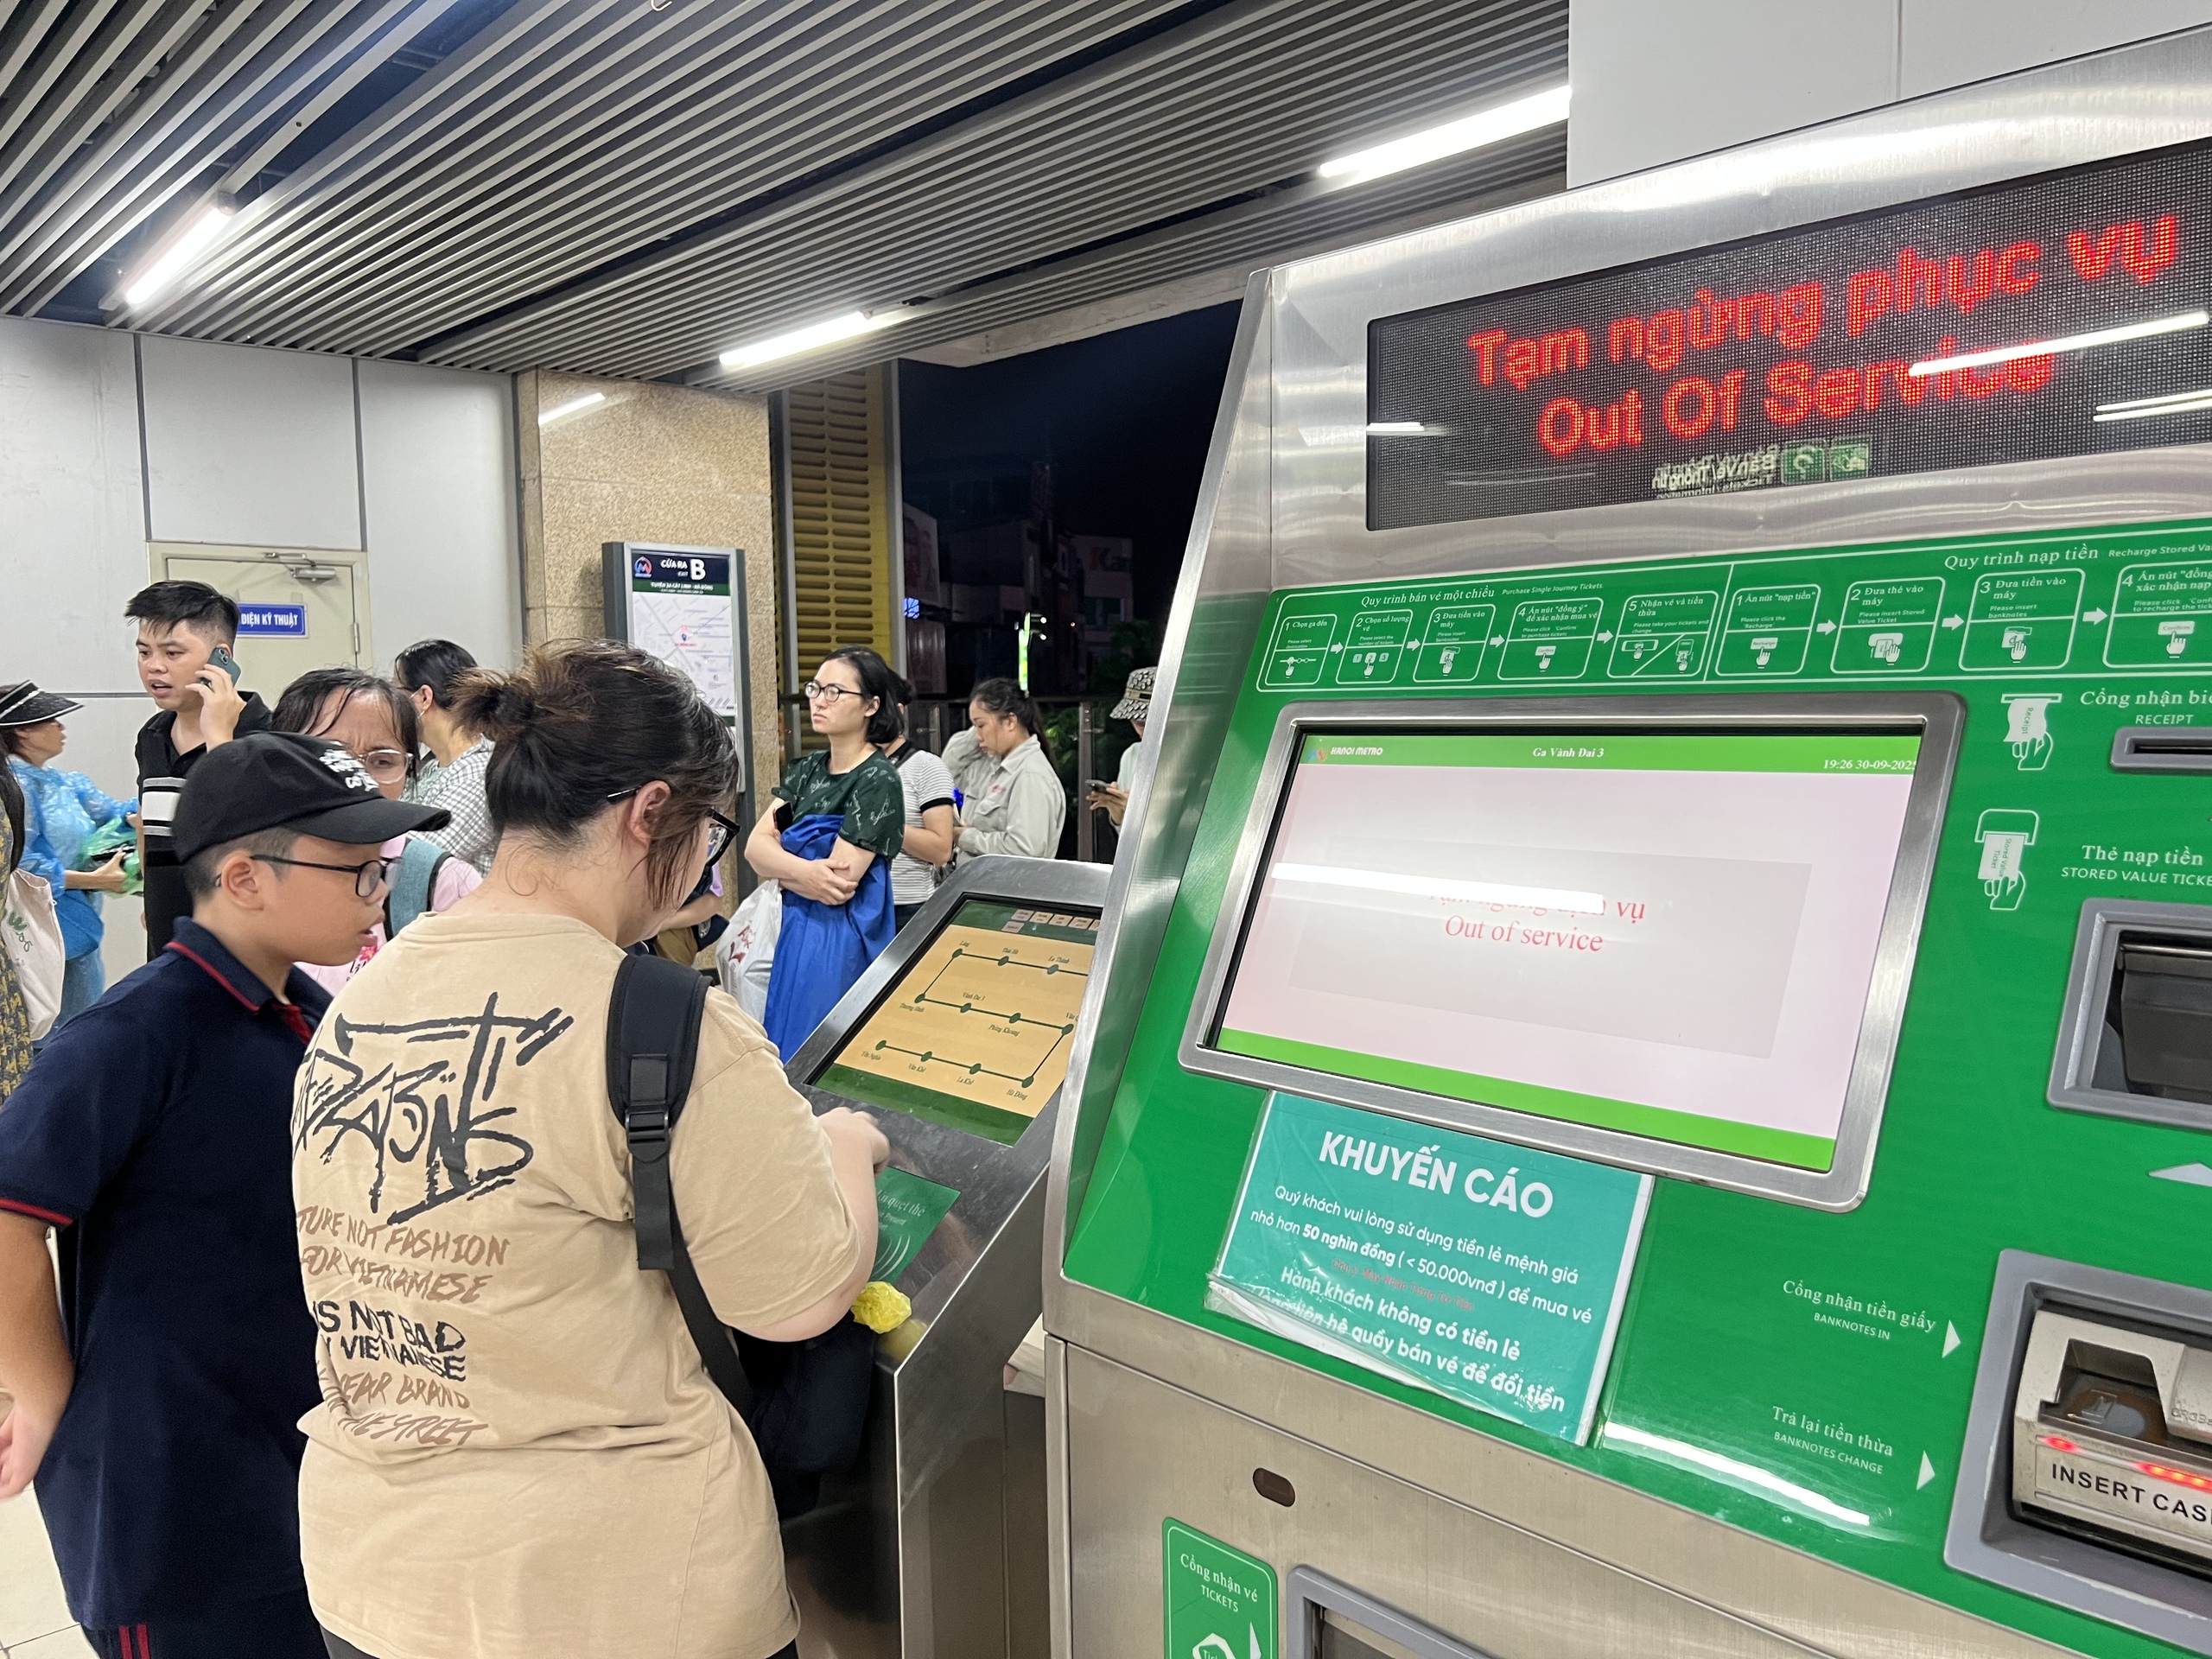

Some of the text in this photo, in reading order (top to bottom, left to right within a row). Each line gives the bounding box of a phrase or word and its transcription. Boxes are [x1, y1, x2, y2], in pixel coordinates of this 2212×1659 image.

[1470, 214, 2176, 391] Tạm ngừng phục vụ
[1539, 337, 2053, 455] Out Of Service
[1944, 543, 2099, 570] Quy trình nạp tiền
[2108, 543, 2196, 557] Recharge Stored
[690, 558, 706, 581] B
[2122, 570, 2177, 587] 4 nút
[1361, 584, 1495, 607] Quy trình bán vé một chiều
[1502, 585, 1579, 596] Purchase Single Journey
[1850, 588, 1861, 601] 2
[1864, 587, 1885, 596] Đưa
[1906, 585, 1923, 594] vào
[1980, 575, 2066, 594] 3 Đưa tiền vào
[1993, 590, 2017, 601] máy
[2136, 581, 2211, 592] xác nhận nạp
[1518, 607, 1526, 617] 4
[1629, 601, 1637, 612] 5
[1641, 599, 1662, 608] Nhận
[1688, 594, 1704, 605] tiền
[1736, 596, 1743, 607] 1
[1862, 597, 1883, 607] máy
[241, 611, 260, 627] ĐIỆN
[274, 612, 298, 628] THUẬT
[1356, 617, 1363, 627] 2
[1433, 613, 1441, 623] 3
[2080, 687, 2183, 709] Cổng nhận
[2022, 707, 2034, 734] Receipt
[2135, 714, 2194, 725] RECEIPT
[1331, 747, 1383, 756] HANOI METRO
[1532, 747, 1605, 758] Ga Vành 3
[1823, 760, 1853, 770] 19:26
[2082, 844, 2203, 867] Thẻ nạp tiền
[2061, 867, 2168, 884] STORED VALUE
[1616, 899, 1646, 925] vụ
[1445, 914, 1603, 952] Out of service
[1319, 1130, 1554, 1218] KHUYẾN CÁO
[346, 1214, 389, 1250] NOT
[385, 1225, 511, 1267] FASHION
[1274, 1185, 1579, 1285] Quý khách vui lòng sử dụng tiền lẻ mệnh giá
[344, 1250, 493, 1304] VIETNAMESE
[1250, 1210, 1274, 1227] nhỏ
[1276, 1215, 1301, 1235] hơn
[1302, 1223, 1320, 1241] 50
[1360, 1242, 1396, 1268] đồng
[1397, 1250, 1406, 1268] (
[1416, 1259, 1498, 1295] 50.000vnđ
[1497, 1280, 1505, 1300] )
[1508, 1287, 1532, 1305] để
[1532, 1295, 1568, 1317] mua
[1572, 1306, 1592, 1325] vé
[1281, 1265, 1322, 1294] Hành
[1324, 1279, 1375, 1313] khách
[1376, 1298, 1432, 1336] không
[1434, 1321, 1459, 1340] có
[1461, 1327, 1498, 1354] tiền
[1501, 1338, 1521, 1361] lẻ
[1783, 1279, 1936, 1333] Cổng nhận tiền giấy
[397, 1313, 467, 1355] BAD
[1814, 1312, 1891, 1340] BANKNOTES IN
[340, 1335, 467, 1382] VIETNAMESE
[1351, 1325, 1565, 1413] quầy bán vé để đổi tiền
[396, 1373, 471, 1409] BRAND
[1772, 1405, 1893, 1457] Trả lại tiền thừa
[1774, 1431, 1884, 1475] BANKNOTES CHANGE
[2051, 1463, 2212, 1526] INSERT CAS
[1180, 1553, 1258, 1603] Cổng nhận vé
[1200, 1584, 1239, 1613] TICKETS
